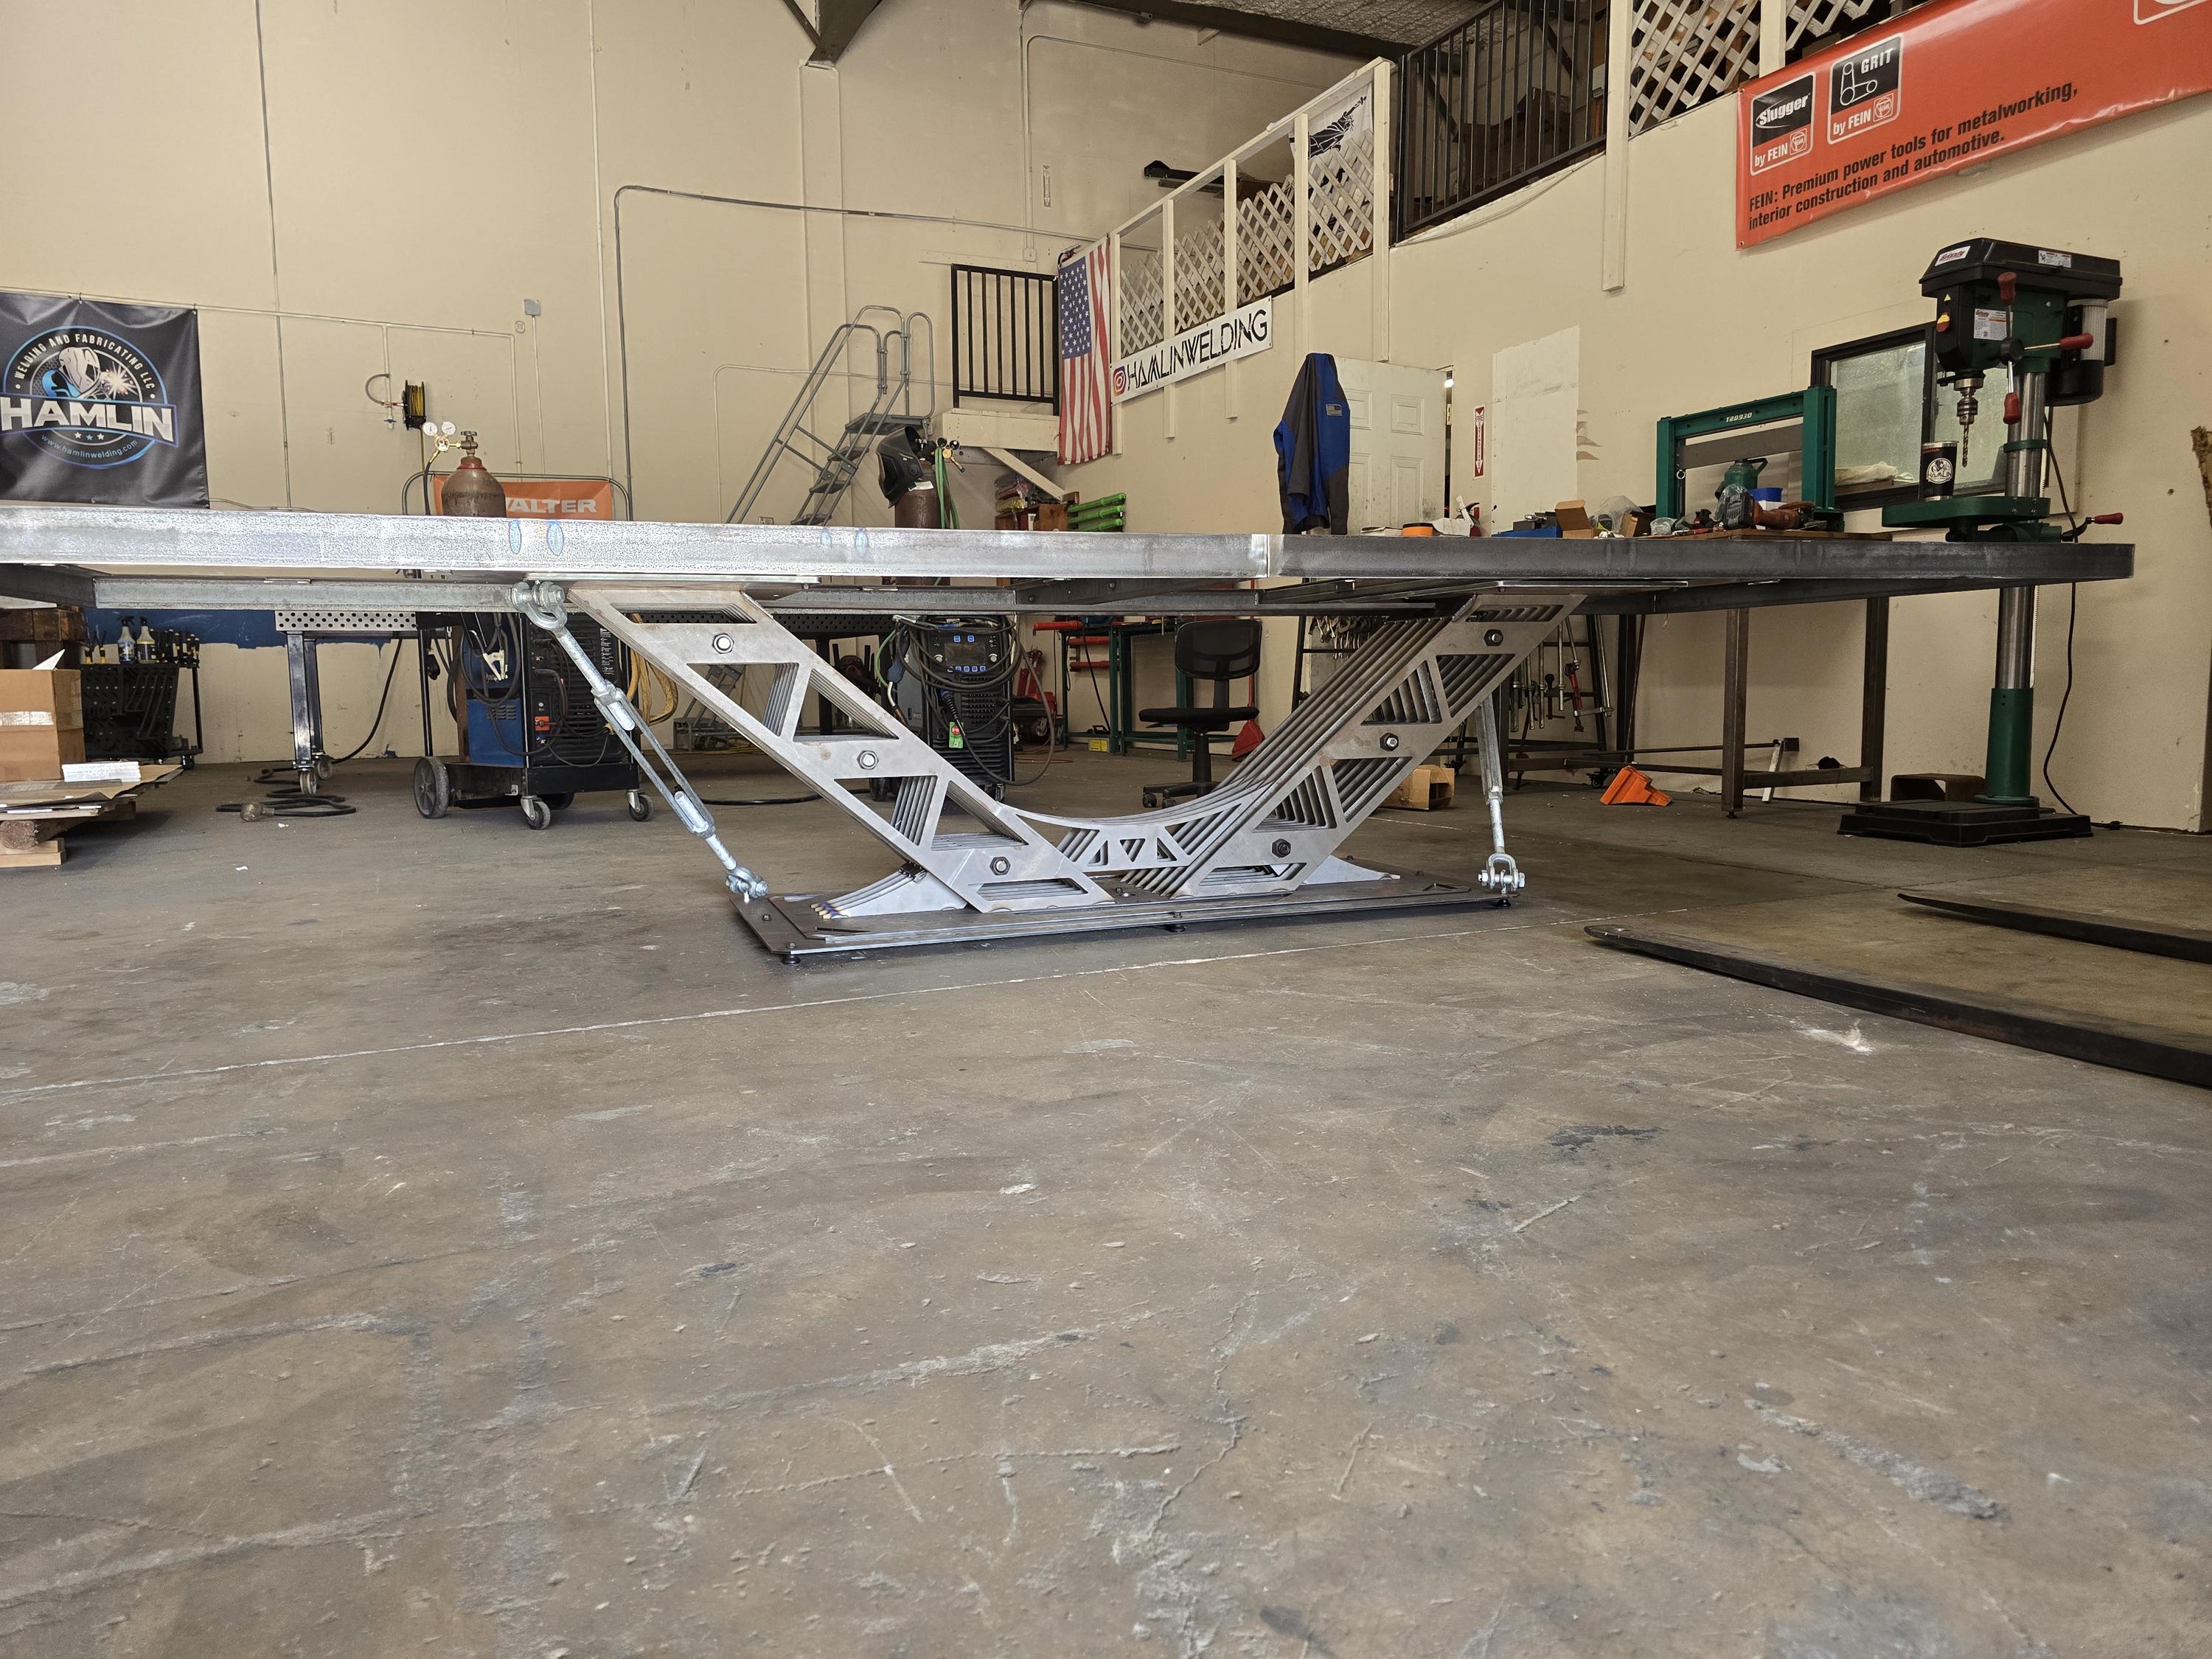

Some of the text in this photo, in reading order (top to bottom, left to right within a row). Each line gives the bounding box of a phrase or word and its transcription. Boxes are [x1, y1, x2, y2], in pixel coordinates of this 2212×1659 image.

[1861, 49, 1894, 74] GRIT
[1759, 94, 1809, 126] Slugger
[1833, 109, 1871, 136] by FEIN
[1749, 82, 2078, 212] FEIN: Premium power tools for metalworking,
[1754, 142, 1788, 167] by FEIN
[1749, 130, 2005, 230] interior construction and automotive.
[15, 333, 156, 389] WELDING AND FABRICATING LLC
[0, 397, 174, 442] HAMLIN
[41, 434, 139, 459] www.hamlinwelding.com
